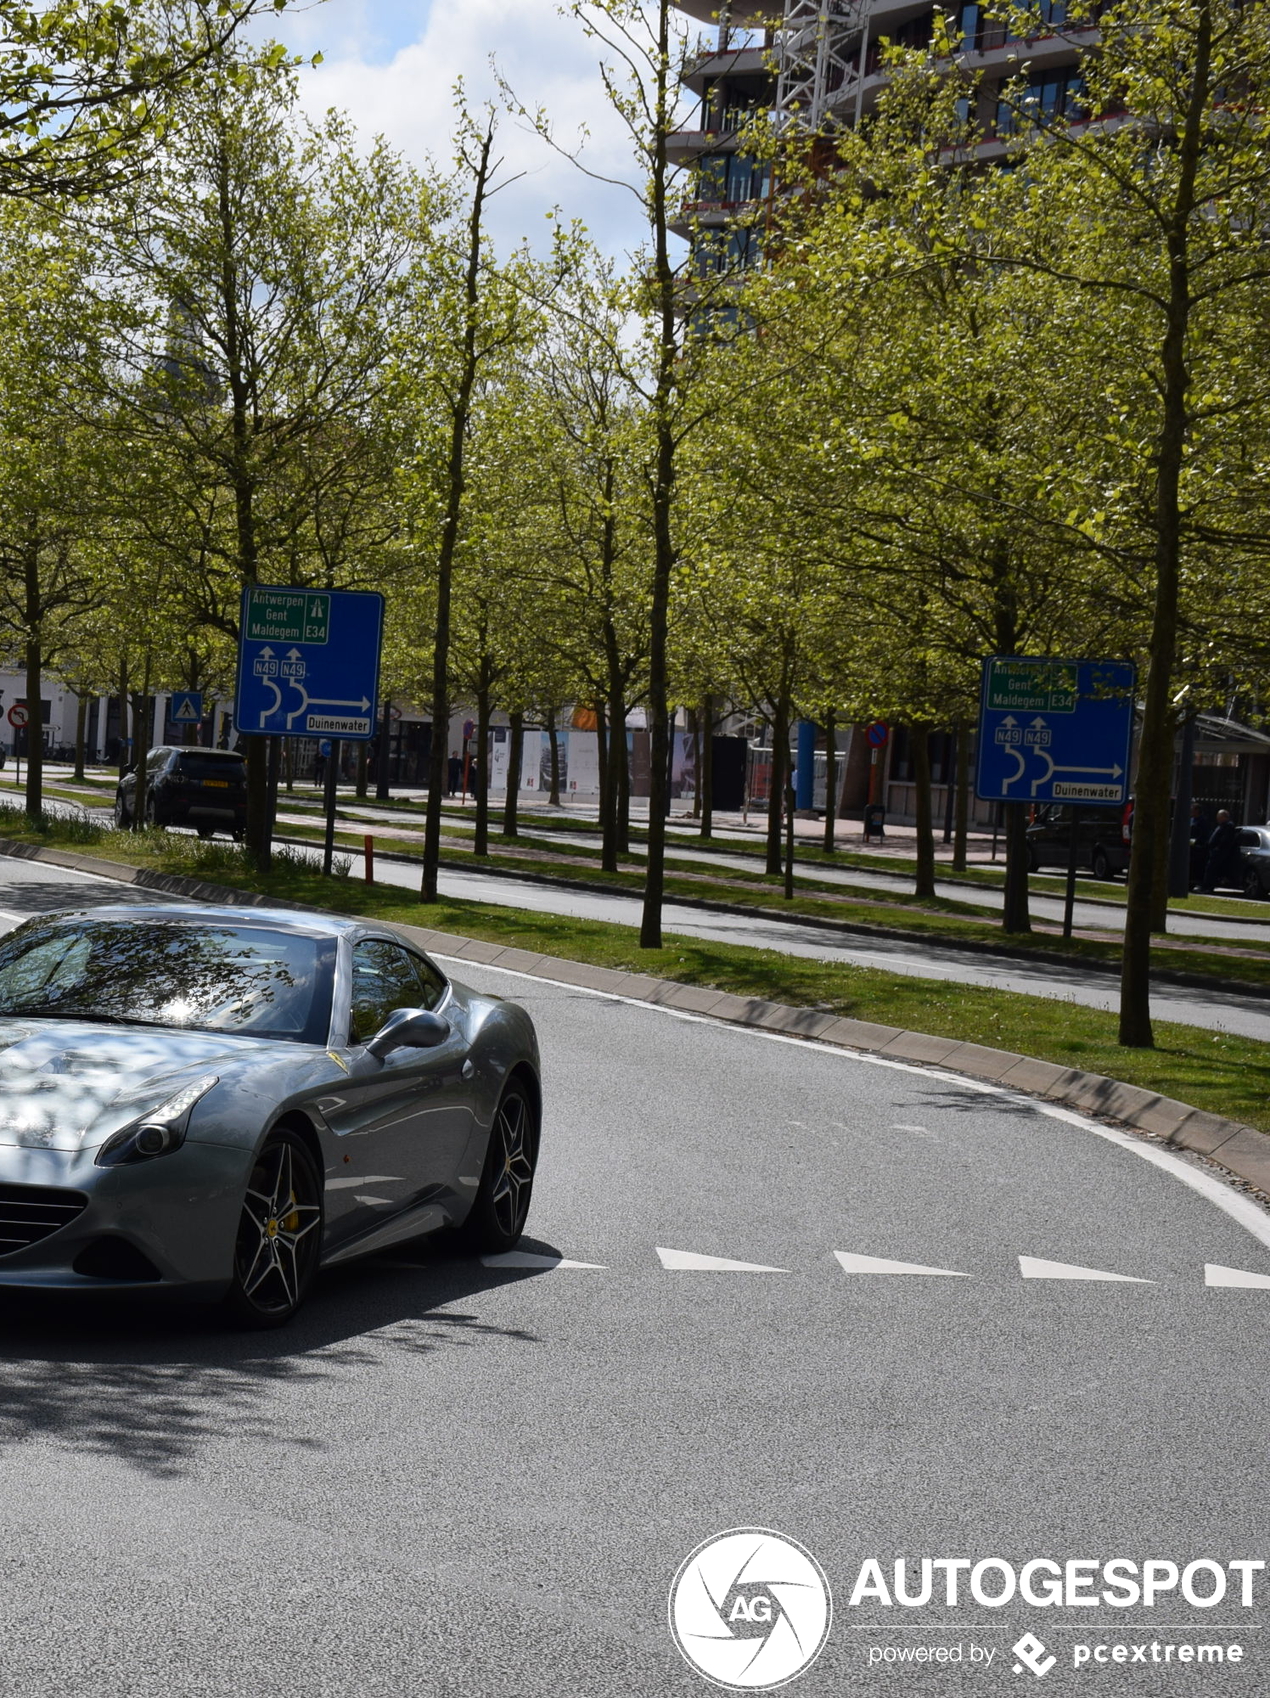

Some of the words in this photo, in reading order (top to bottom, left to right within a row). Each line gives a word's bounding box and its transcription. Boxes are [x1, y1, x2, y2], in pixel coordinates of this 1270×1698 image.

[252, 591, 304, 609] Antwerpen
[266, 609, 288, 621] Gent
[252, 623, 300, 639] Maldegem
[306, 625, 326, 638] E34
[256, 663, 277, 675] N49
[283, 664, 304, 676] N49
[1008, 678, 1032, 691] Gent
[993, 692, 1045, 709] Maldegem
[1051, 694, 1073, 707] E34
[309, 717, 368, 732] Duinenwater
[998, 730, 1019, 742] N49
[1027, 732, 1049, 744] N49
[1055, 784, 1120, 799] Duinenwater
